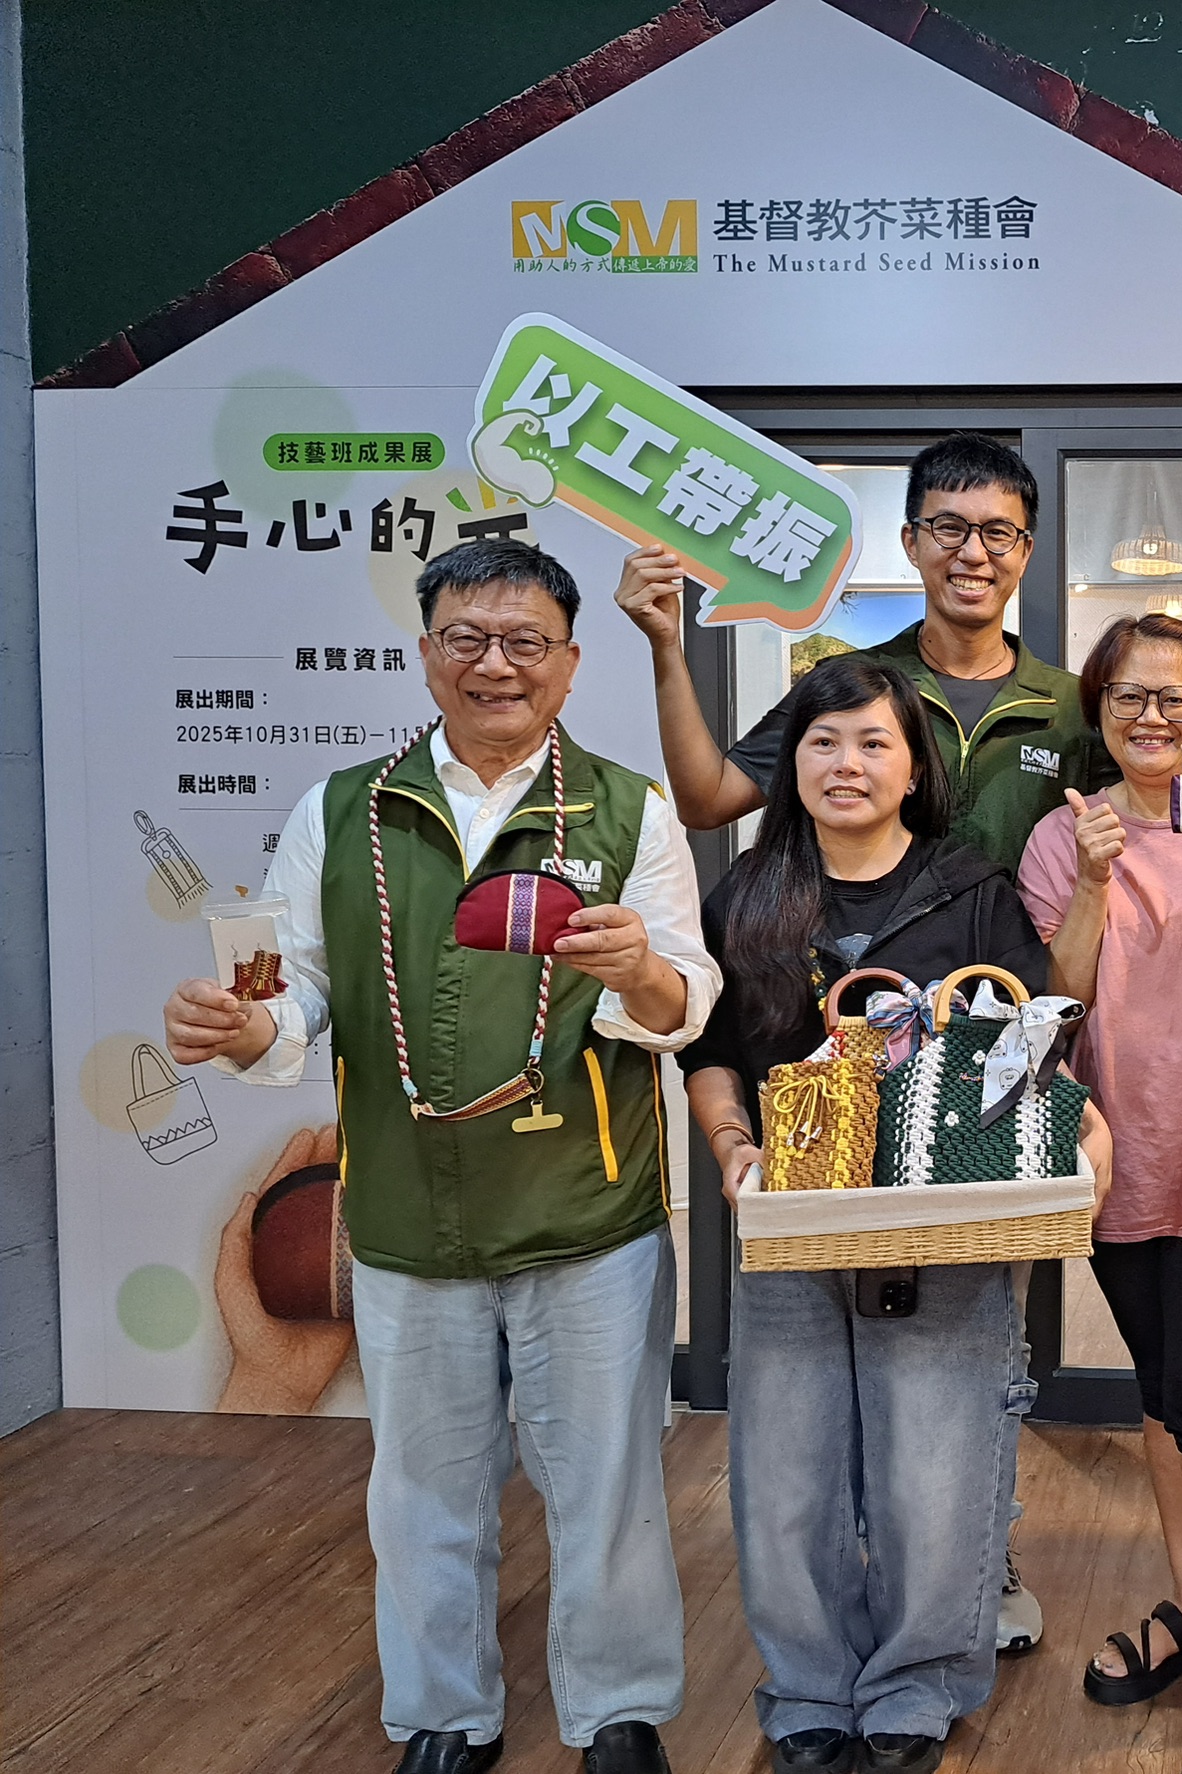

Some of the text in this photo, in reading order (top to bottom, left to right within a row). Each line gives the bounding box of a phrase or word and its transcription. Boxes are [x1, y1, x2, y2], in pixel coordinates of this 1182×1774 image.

[713, 195, 1038, 241] 基督教芥菜種會
[713, 252, 1041, 272] The Mustard Seed Mission
[277, 441, 433, 464] 技藝班成果展
[502, 353, 838, 583] 以工帶振
[295, 647, 406, 671] 展覽資訊
[175, 689, 268, 709] 展出期間：
[178, 774, 270, 794] 展出時間：
